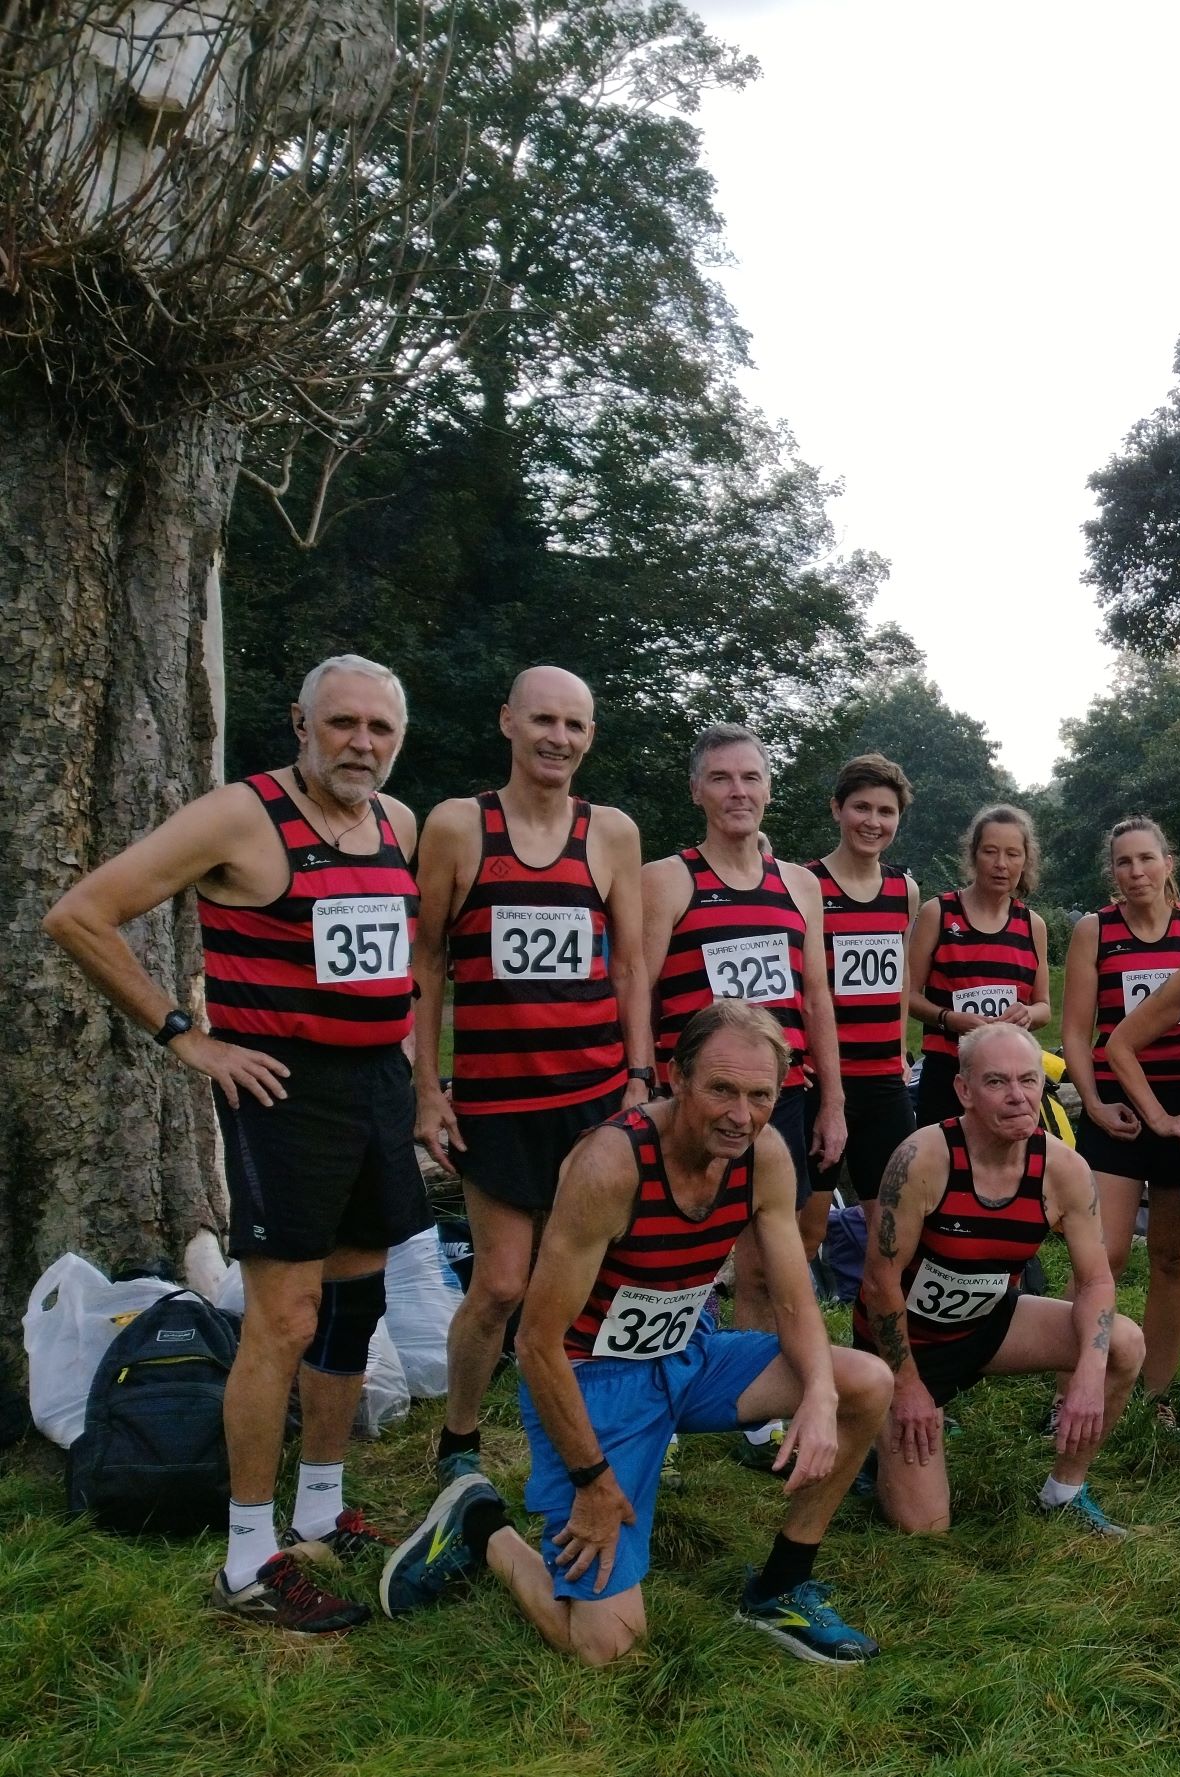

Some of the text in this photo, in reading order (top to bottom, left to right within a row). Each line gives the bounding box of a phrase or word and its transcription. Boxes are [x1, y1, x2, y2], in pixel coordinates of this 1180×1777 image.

[317, 905, 355, 916] SURREY
[357, 904, 388, 914] COUNTY
[496, 911, 587, 921] SURREY COUNTY AA
[326, 923, 400, 977] 357
[502, 927, 583, 974] 324
[707, 939, 784, 956] SURREY COUNTY AA
[837, 939, 863, 947] SURREY
[864, 938, 890, 946] COUNTY
[716, 954, 787, 999] 325
[841, 948, 898, 987] 206
[1126, 973, 1153, 981] SURREY
[955, 990, 980, 1000] SURREY
[981, 988, 1005, 996] COUNTY
[924, 1263, 956, 1282] SURREY
[957, 1278, 990, 1286] COUNTY
[621, 1290, 662, 1305] SURREY
[663, 1293, 696, 1305] COUNTY
[916, 1280, 997, 1319] 327
[607, 1306, 695, 1355] 326
